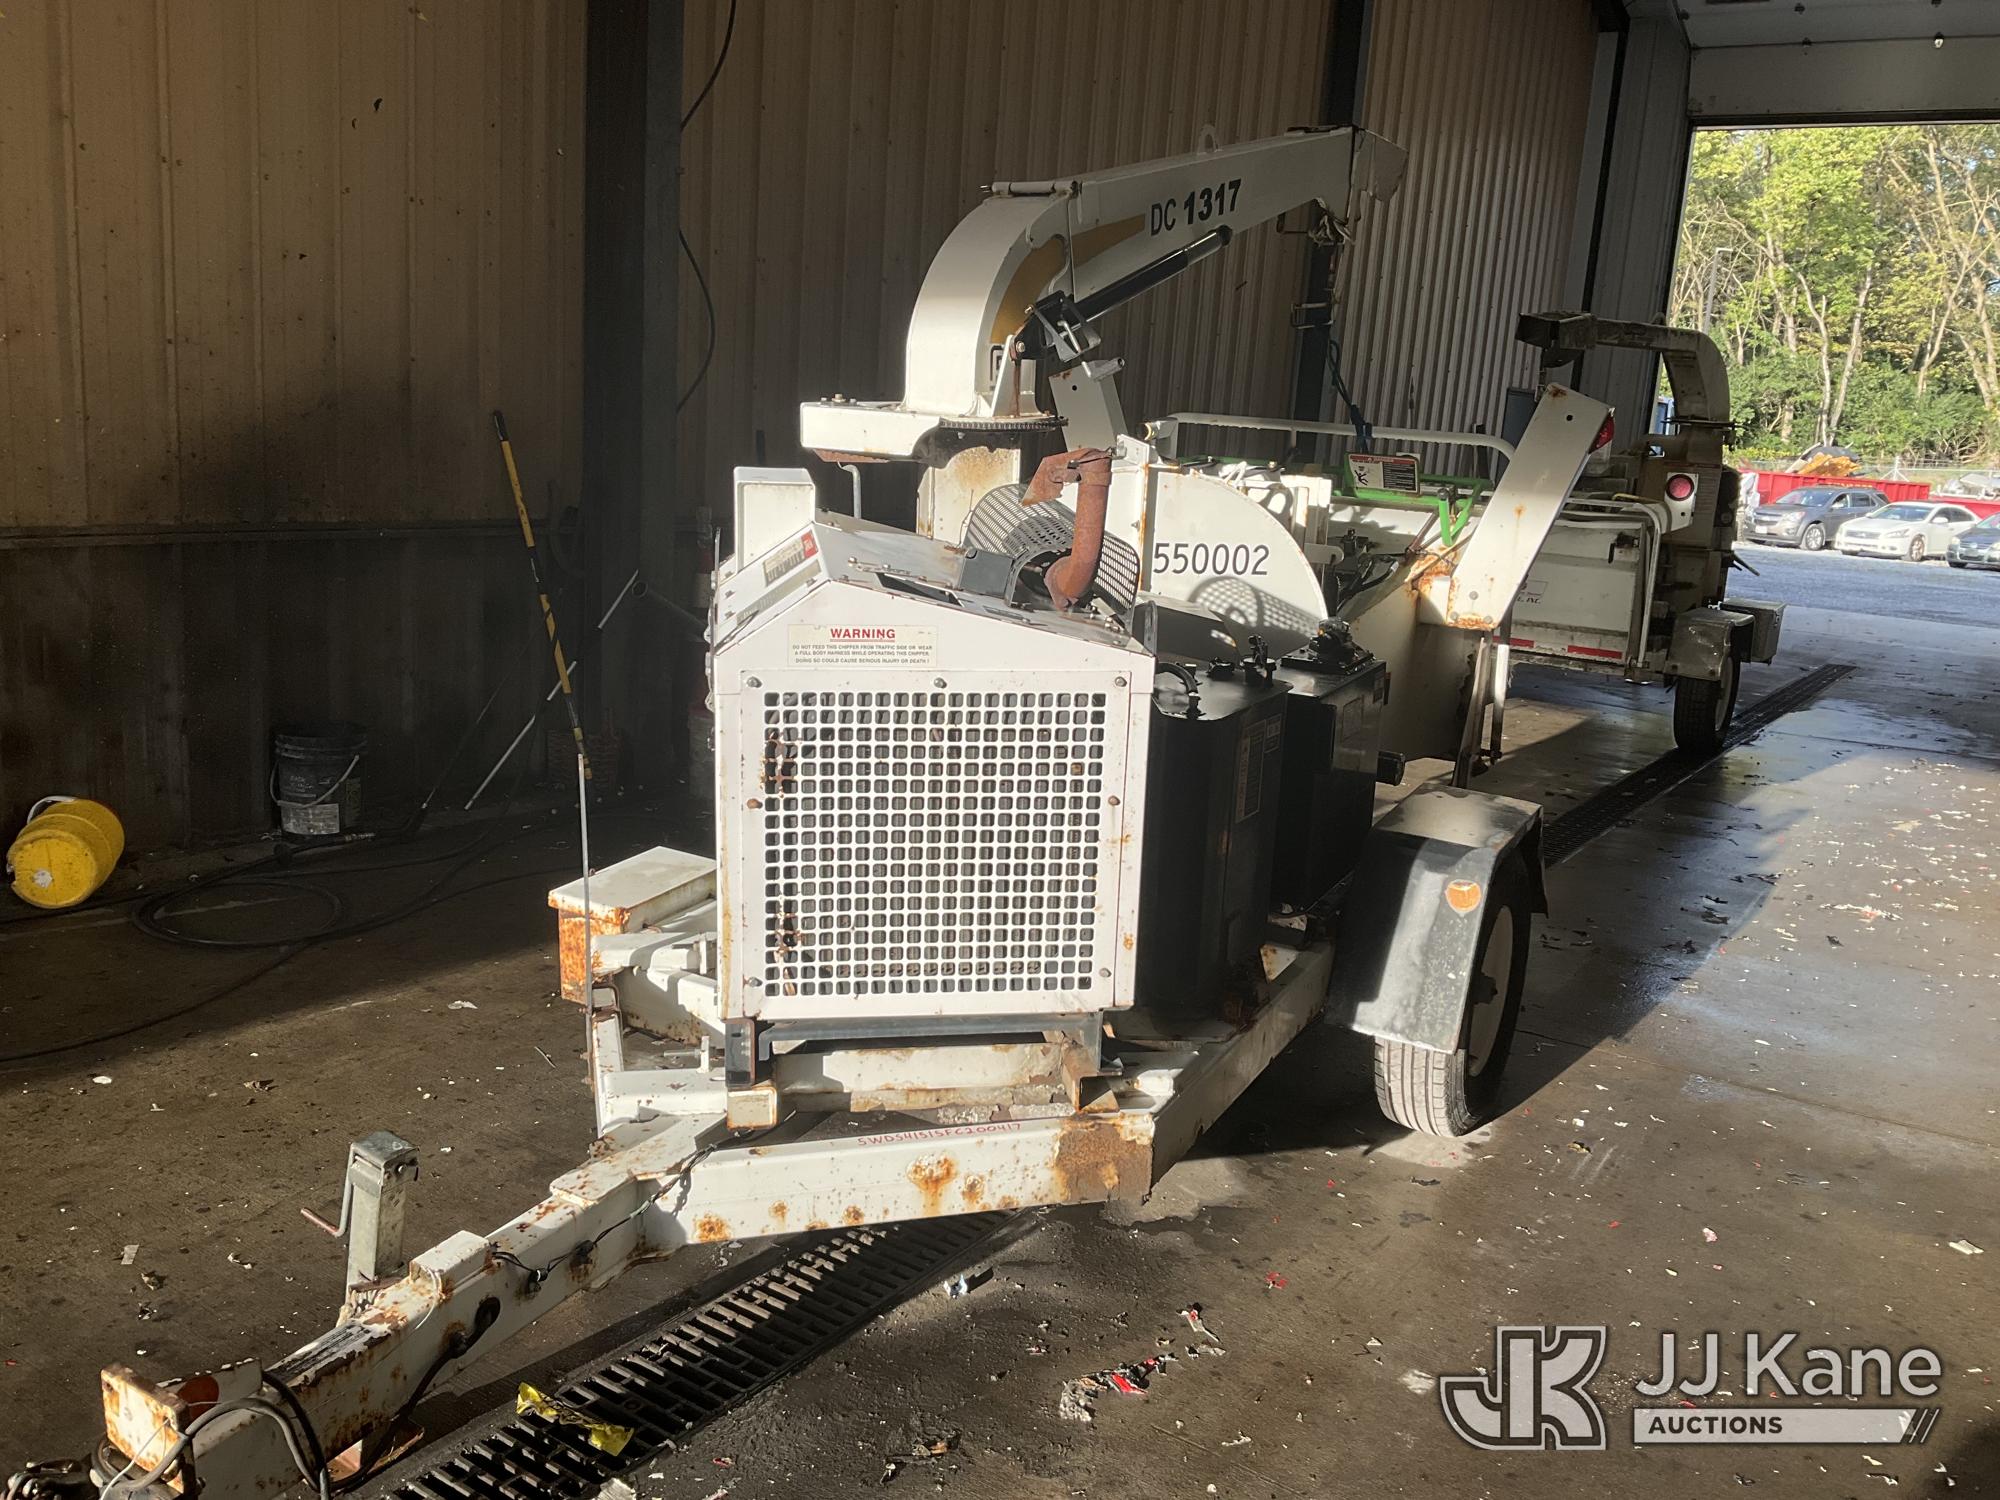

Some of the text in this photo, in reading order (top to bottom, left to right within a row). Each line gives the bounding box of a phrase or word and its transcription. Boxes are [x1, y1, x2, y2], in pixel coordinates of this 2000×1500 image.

[1151, 178, 1242, 237] DC 1317
[1153, 543, 1270, 576] 550002
[830, 628, 896, 639] WARNING
